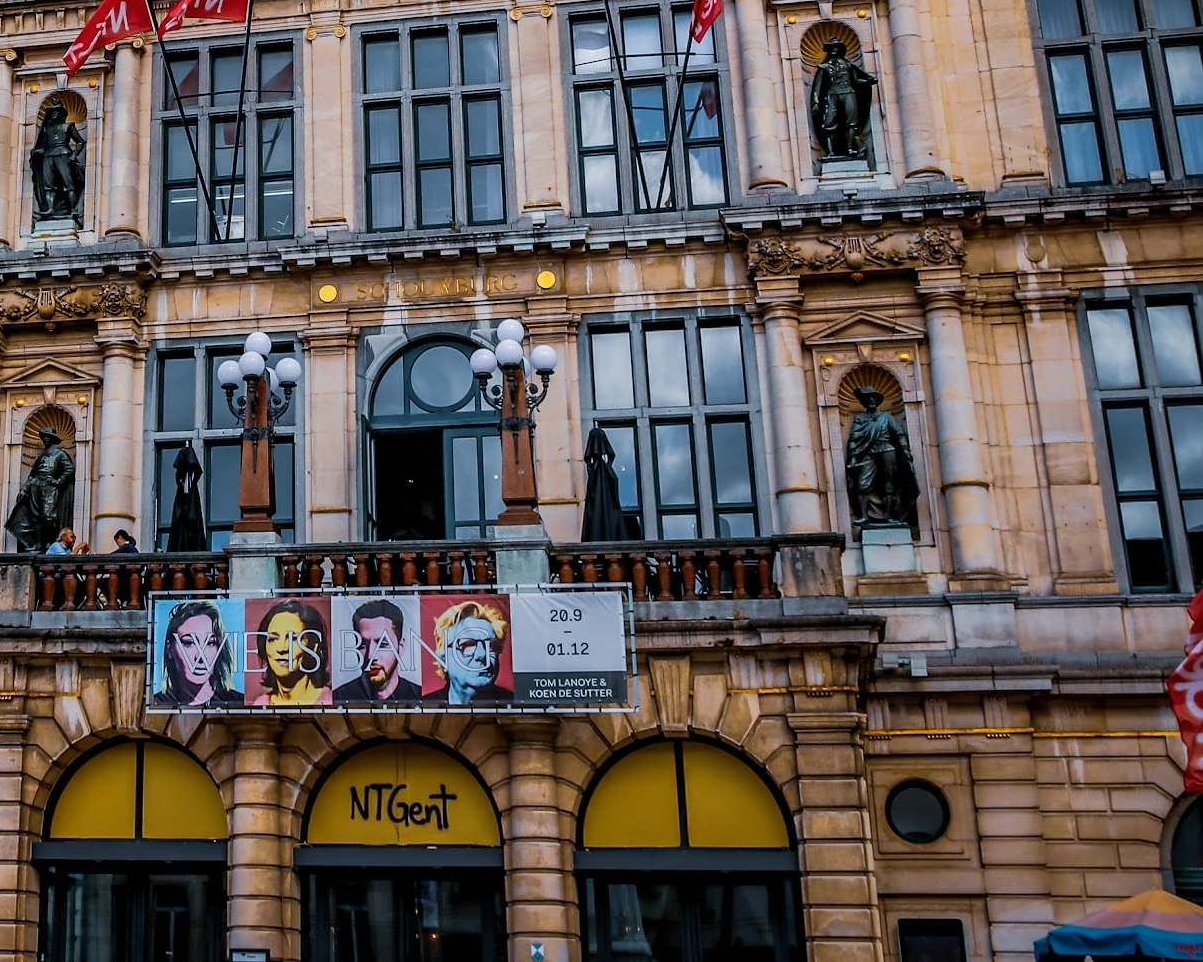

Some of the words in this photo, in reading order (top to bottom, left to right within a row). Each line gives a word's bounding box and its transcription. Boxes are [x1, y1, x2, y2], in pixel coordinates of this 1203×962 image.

[356, 273, 518, 301] SCHOUWBURG
[549, 608, 583, 622] 20.9
[172, 632, 268, 674] WIE
[288, 629, 323, 673] IS
[339, 626, 493, 673] BANG
[546, 642, 590, 656] 01.12
[533, 678, 557, 688] TOM
[558, 677, 598, 687] LANOYE
[599, 677, 608, 687] &
[529, 689, 557, 699] KOEN
[558, 689, 572, 698] DE
[573, 688, 613, 698] SUTTER
[350, 783, 457, 830] NTGent
